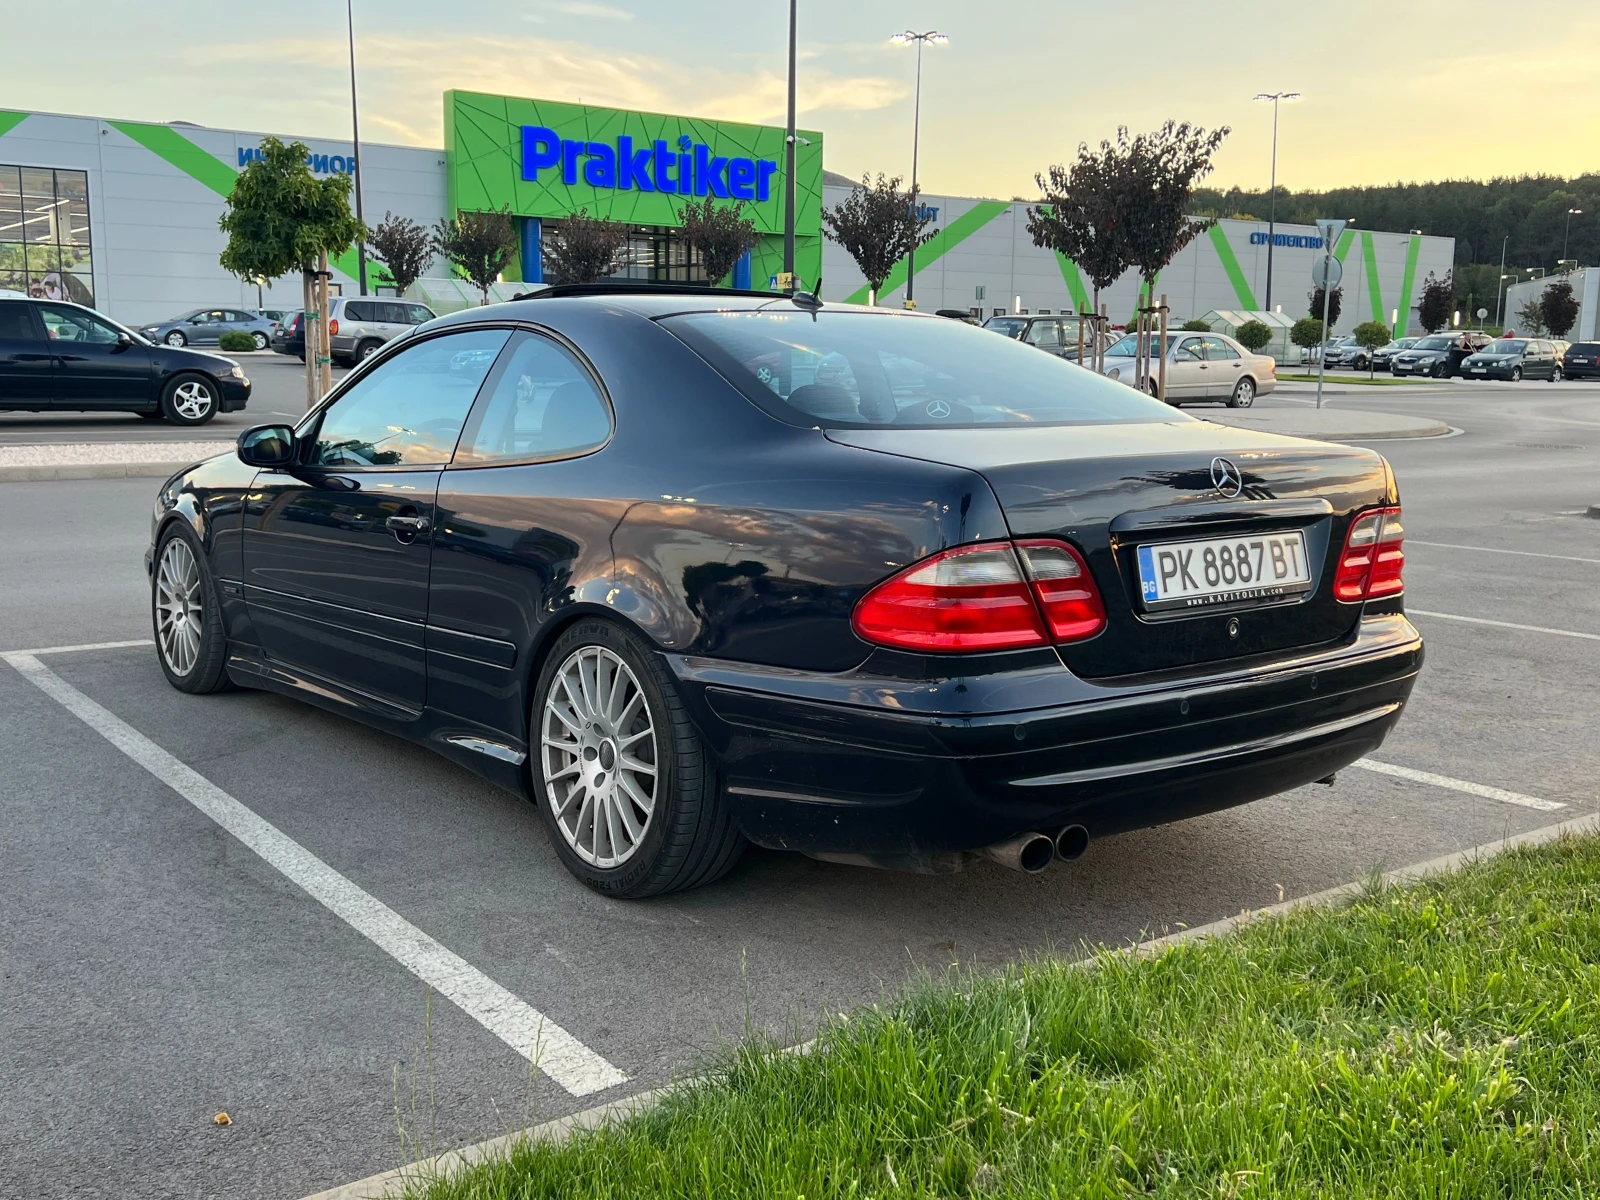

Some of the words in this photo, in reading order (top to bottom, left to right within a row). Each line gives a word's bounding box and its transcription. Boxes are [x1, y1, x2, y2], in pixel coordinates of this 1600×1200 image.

[238, 147, 356, 175] ИИОР
[521, 125, 777, 201] Praktiker
[1158, 548, 1199, 593] PK
[1203, 542, 1264, 587] 8887
[1270, 538, 1299, 579] BT
[1143, 580, 1156, 594] BG
